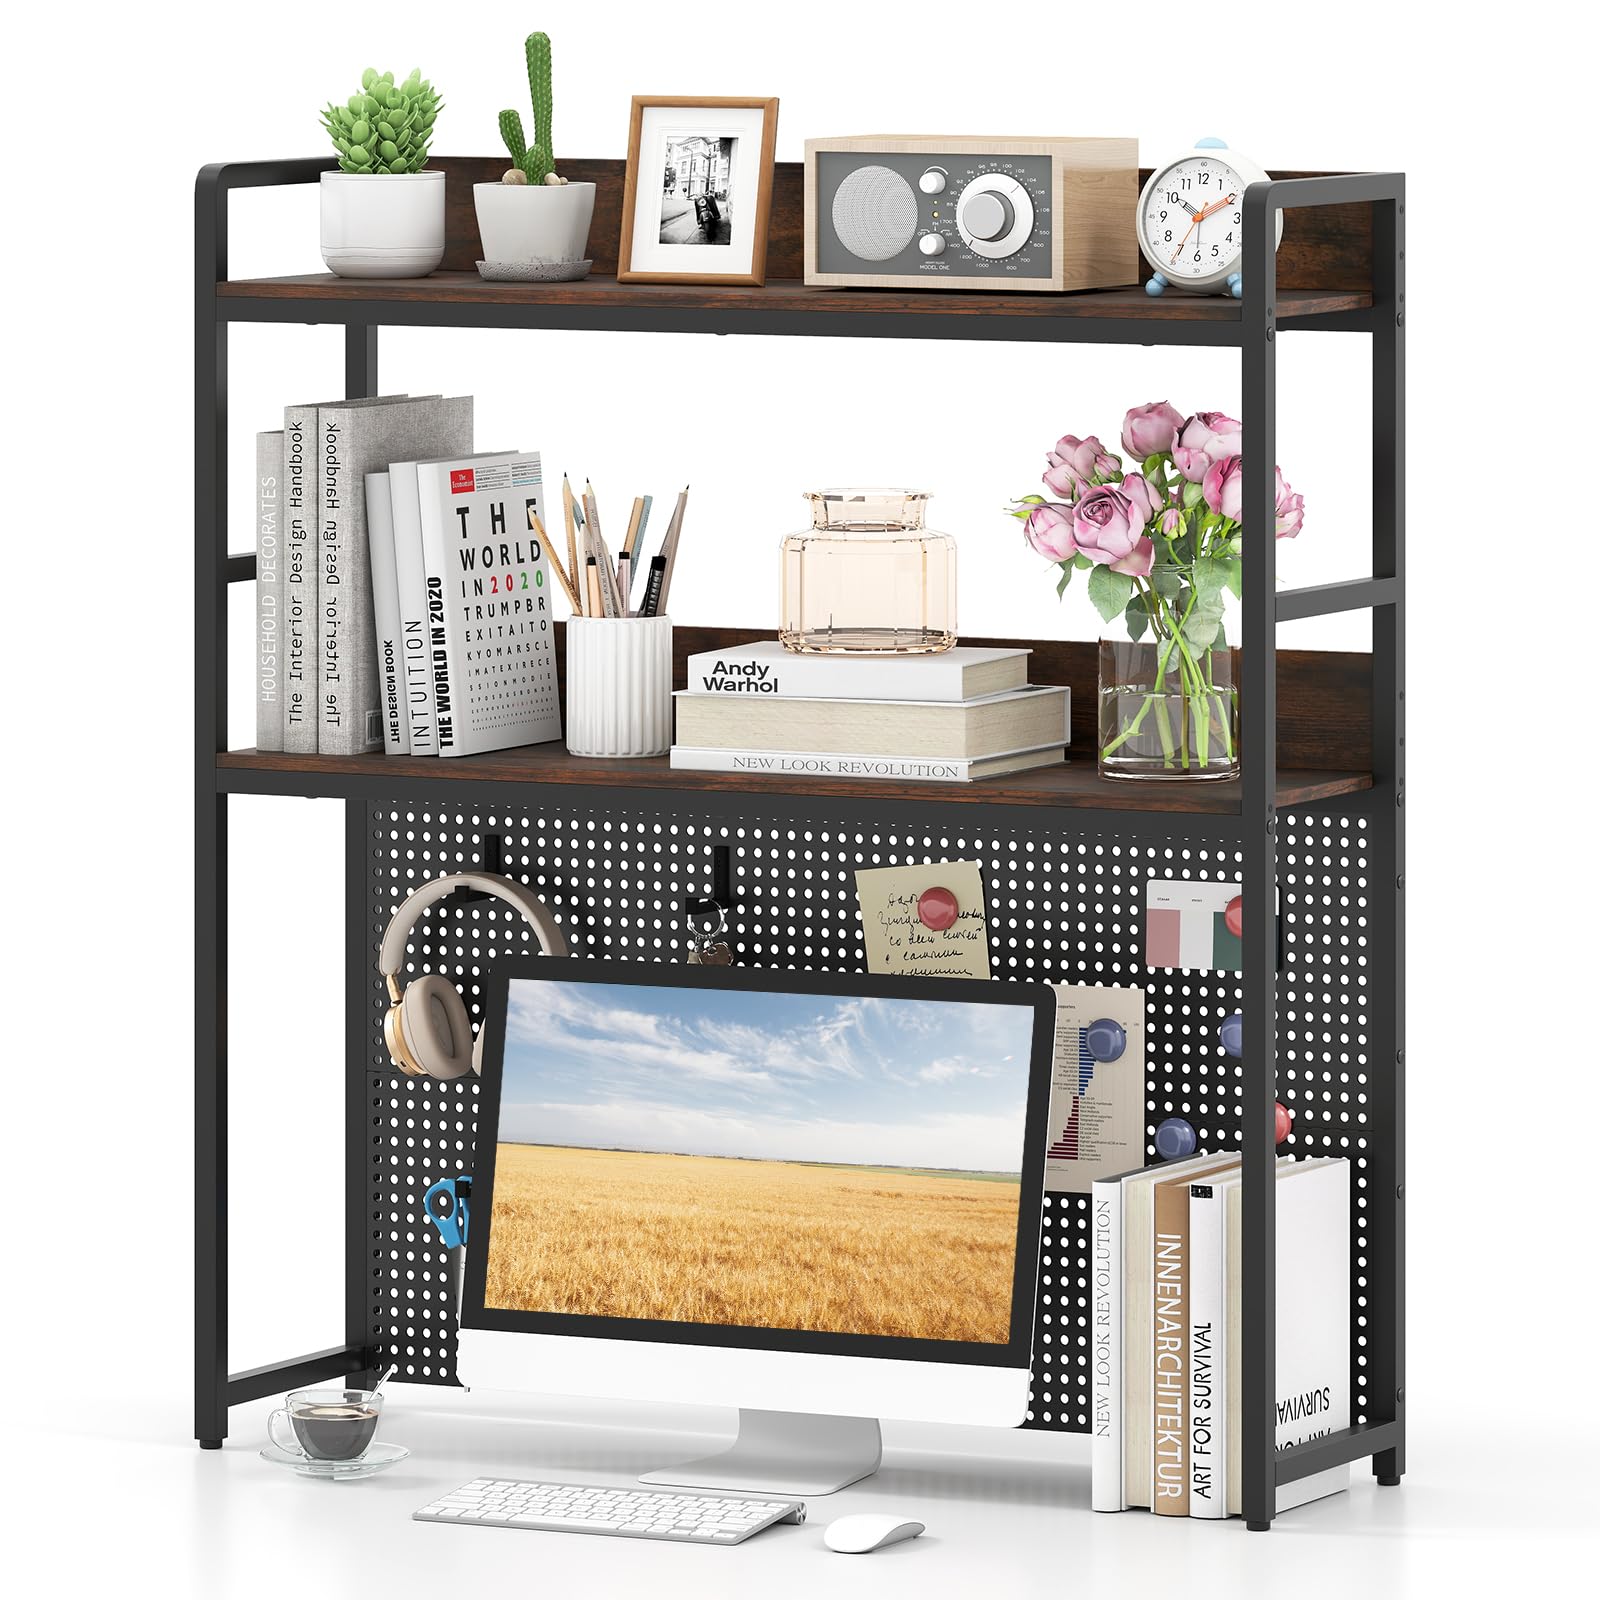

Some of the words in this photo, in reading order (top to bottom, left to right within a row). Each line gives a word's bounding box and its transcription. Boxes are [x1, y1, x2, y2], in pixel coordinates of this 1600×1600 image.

[1181, 179, 1191, 190] 11
[1198, 173, 1209, 184] 12
[1218, 179, 1223, 190] 1
[1166, 192, 1179, 204] 10
[1160, 211, 1167, 222] 9
[1234, 212, 1241, 224] 3
[1165, 230, 1172, 242] 8
[1225, 232, 1232, 243] 4
[1194, 250, 1201, 262] 6
[289, 421, 303, 507] Handbook
[262, 476, 276, 582] DECORATES
[456, 498, 537, 538] THE
[289, 519, 307, 583] Design
[460, 540, 541, 571] WORLD
[462, 578, 483, 598] IN
[491, 569, 543, 594] 2020
[427, 576, 444, 623] 2020
[464, 596, 546, 621] TRUMPBR
[289, 595, 303, 680] Interior
[431, 627, 446, 645] IN
[465, 619, 547, 642] EXITAITO
[262, 595, 276, 701] HOUSEHOLD
[405, 621, 431, 747] INTUITION
[433, 650, 451, 713] WORLD
[703, 677, 778, 693] Warhol
[712, 660, 770, 680] Andy
[289, 693, 302, 724] The
[438, 716, 454, 749] THE
[733, 757, 775, 769] NEW
[780, 759, 832, 773] LOOK
[838, 762, 959, 777] REVOLUTION
[1096, 1200, 1110, 1327] REVOLUTION
[1097, 1334, 1110, 1387] LOOK
[1157, 1233, 1183, 1498] INNENARCHITEKTUR
[1193, 1322, 1213, 1409] SURVIVAL
[1097, 1393, 1110, 1438] NEW
[1193, 1416, 1212, 1455] FOR
[1193, 1462, 1212, 1499] ART
